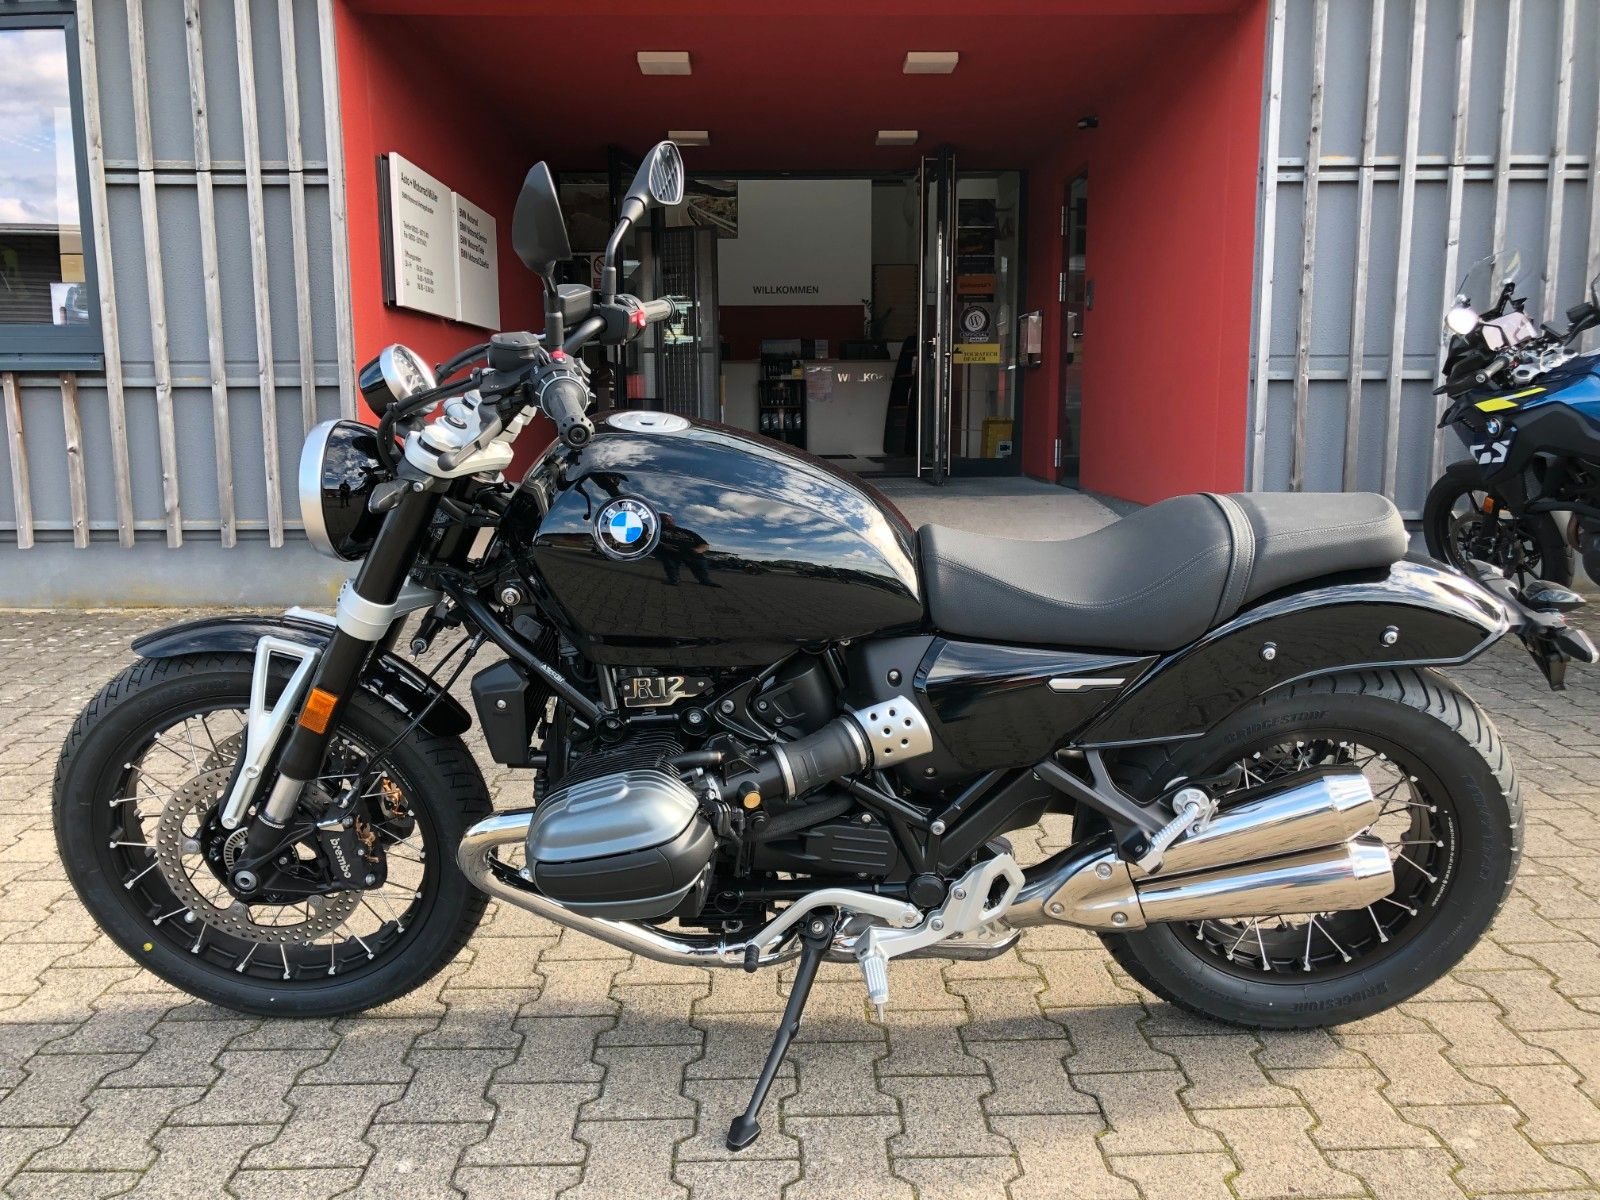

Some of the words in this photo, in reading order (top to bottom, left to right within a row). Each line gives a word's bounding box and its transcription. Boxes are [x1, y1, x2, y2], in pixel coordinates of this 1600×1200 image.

[753, 286, 819, 294] WILLKOMMEN
[605, 502, 650, 520] BMW
[330, 837, 352, 879] brembo
